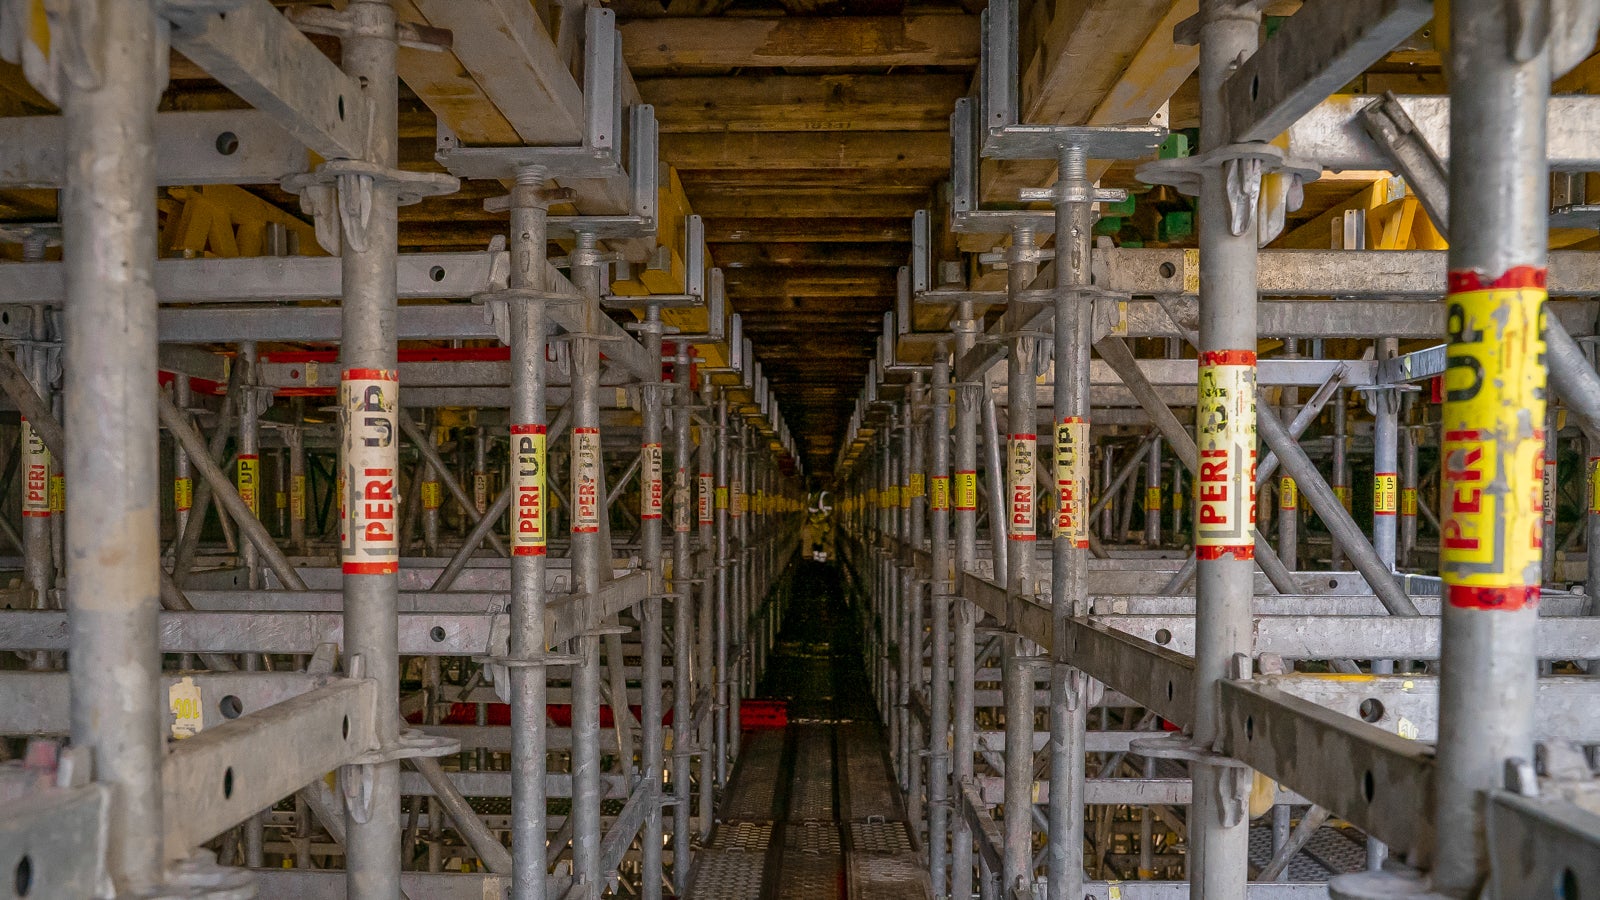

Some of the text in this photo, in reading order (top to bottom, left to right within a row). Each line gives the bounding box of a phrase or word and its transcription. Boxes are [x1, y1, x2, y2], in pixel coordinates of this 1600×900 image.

[1445, 302, 1484, 550] PERI UP
[28, 464, 45, 501] PERI
[241, 461, 253, 507] ERI UP
[364, 385, 393, 541] PERI UP
[519, 436, 539, 532] PERI UP
[652, 449, 661, 507] PERI UP
[966, 475, 973, 486] UP
[1014, 442, 1032, 524] PERI UP
[1283, 479, 1290, 490] UP
[1375, 478, 1381, 490] UP
[1387, 477, 1394, 490] UP
[700, 479, 706, 494] UP
[1200, 450, 1228, 524] PERI
